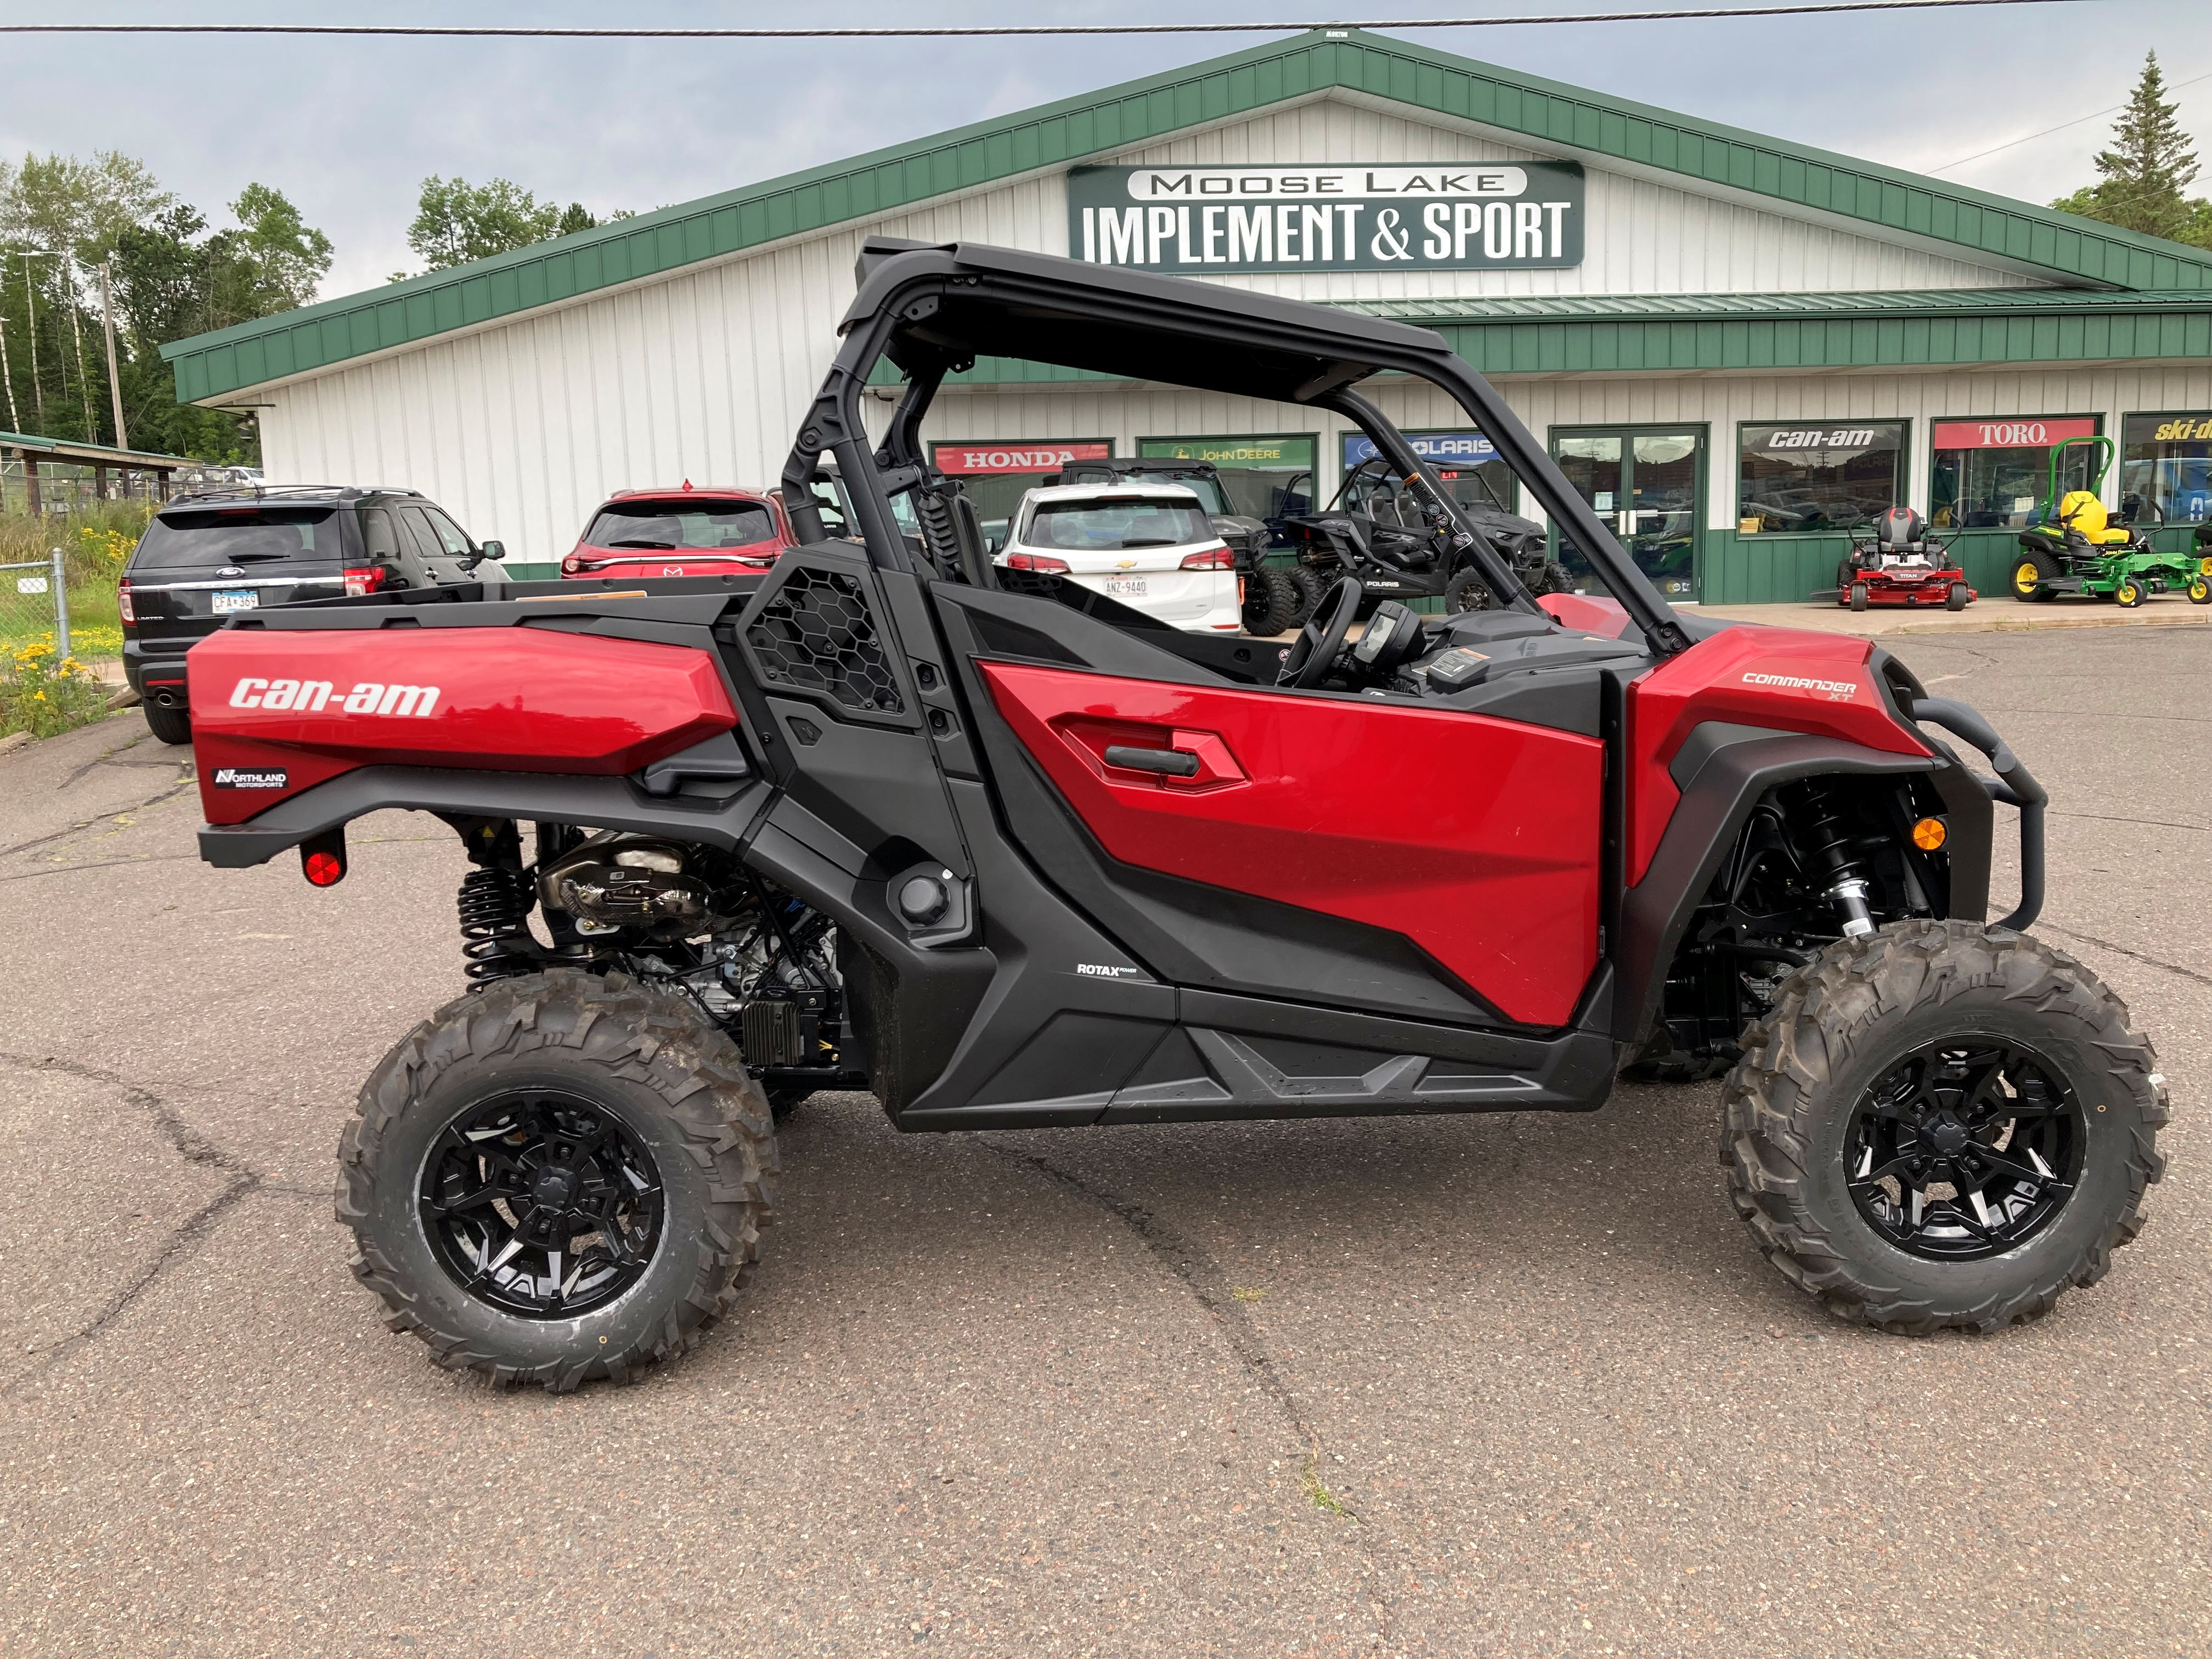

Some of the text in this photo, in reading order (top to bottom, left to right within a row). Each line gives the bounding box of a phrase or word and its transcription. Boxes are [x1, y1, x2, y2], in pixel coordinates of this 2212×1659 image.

[1151, 172, 1505, 195] MOOSE LAKE
[1082, 202, 1571, 264] IMPLEMENT & SPORT
[1769, 430, 1875, 447] can-am
[2154, 419, 2212, 441] ski-d
[1198, 448, 1281, 461] JOHN DEERE
[1408, 439, 1494, 455] OLARIS
[963, 451, 1075, 468] HONDA
[214, 595, 256, 608] CFA 369
[1742, 672, 1857, 693] COMMANDER
[229, 678, 441, 716] can-am
[1827, 692, 1854, 701] XT
[1077, 963, 1120, 977] ROTAX
